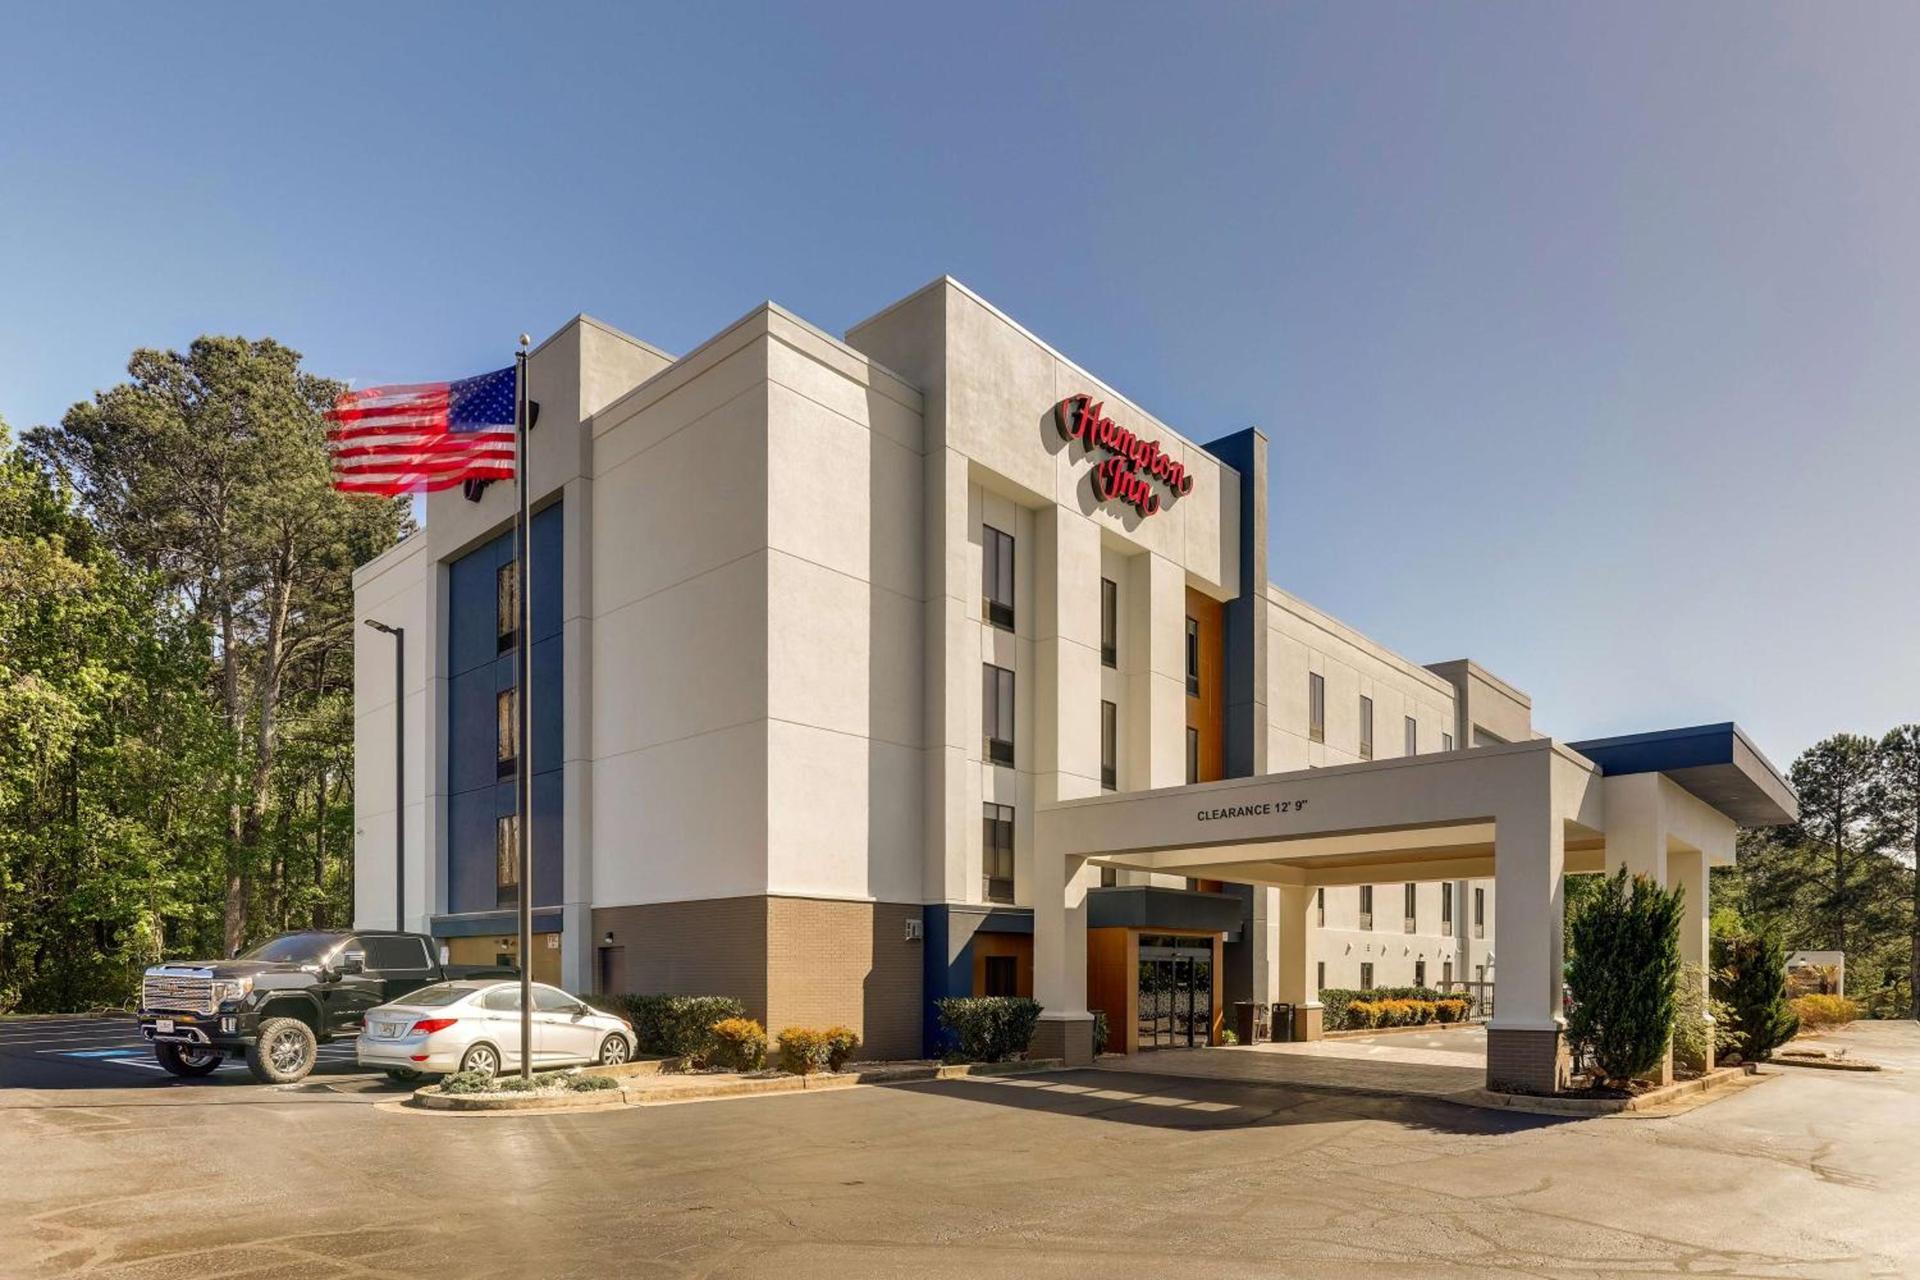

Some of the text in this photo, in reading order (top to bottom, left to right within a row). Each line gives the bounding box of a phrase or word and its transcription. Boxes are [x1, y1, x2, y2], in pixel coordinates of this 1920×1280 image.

[1057, 393, 1193, 496] Hampton
[1094, 456, 1160, 516] Inn
[1197, 803, 1270, 821] CLEARANCE
